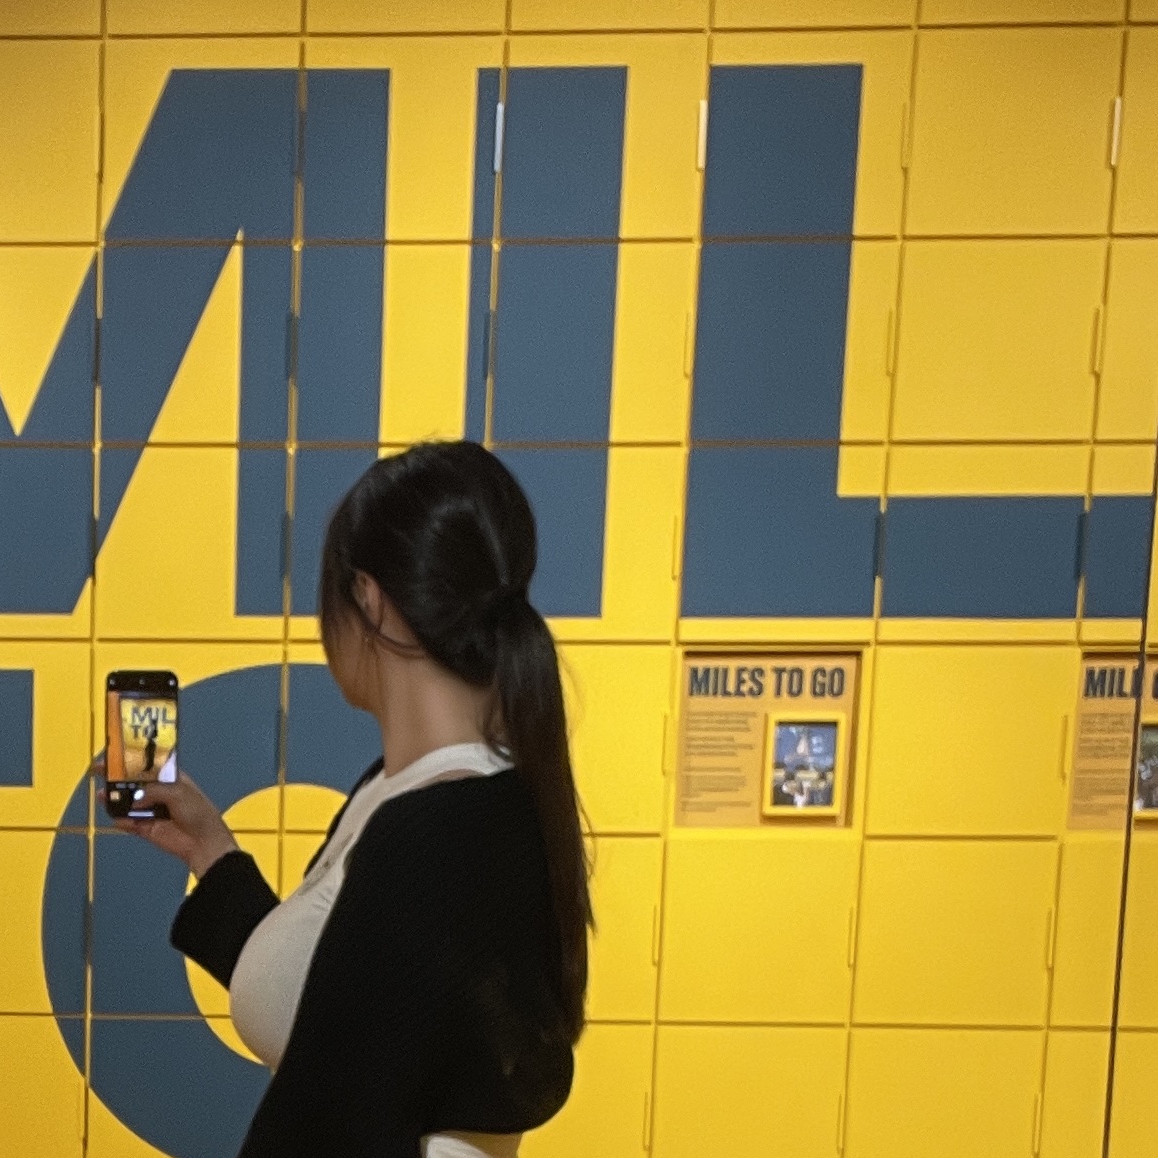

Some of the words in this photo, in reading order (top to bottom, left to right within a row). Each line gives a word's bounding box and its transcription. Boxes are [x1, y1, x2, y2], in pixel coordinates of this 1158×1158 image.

[689, 666, 765, 697] MILES
[773, 666, 804, 697] TO
[811, 666, 845, 698] GO
